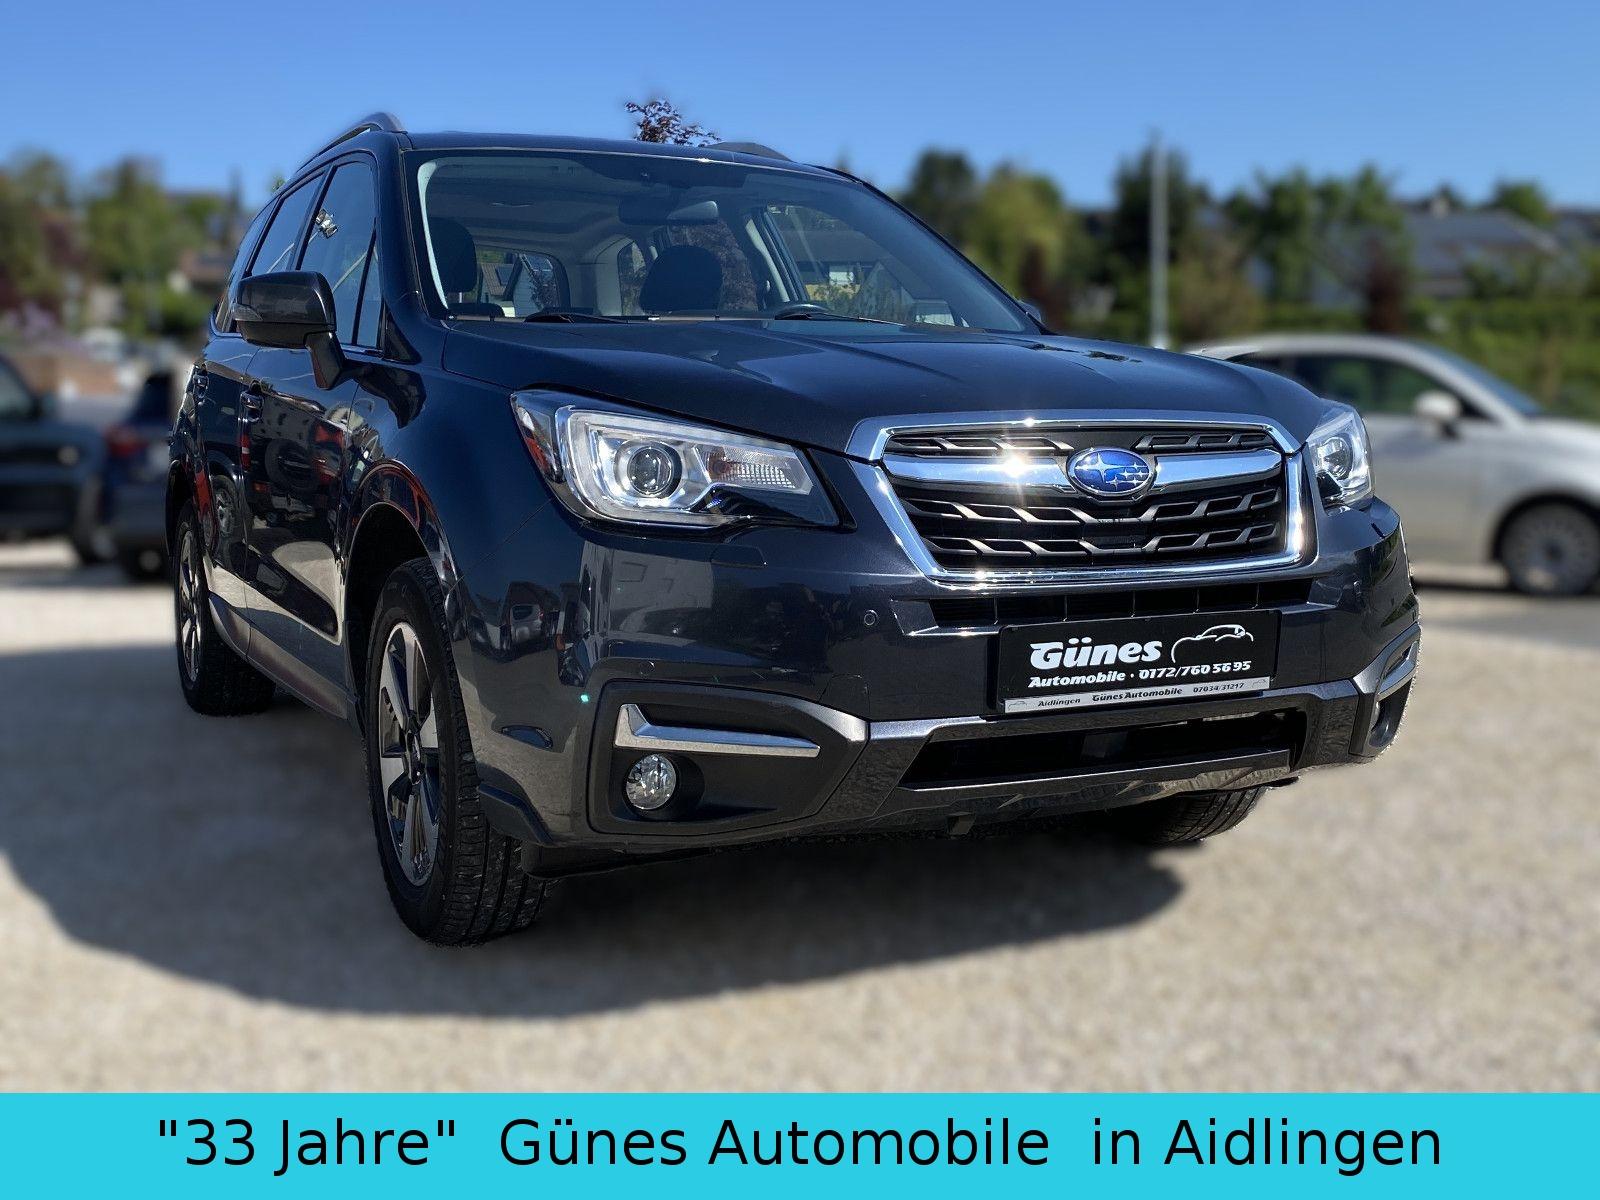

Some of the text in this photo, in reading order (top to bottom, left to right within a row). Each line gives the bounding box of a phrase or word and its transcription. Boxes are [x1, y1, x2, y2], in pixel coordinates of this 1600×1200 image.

[1028, 636, 1163, 670] Günes
[1027, 670, 1126, 688] Automobile
[1139, 664, 1211, 680] 0172/760
[1038, 698, 1081, 707] Aidlingen
[1092, 692, 1123, 702] Günes
[1125, 687, 1183, 700] Automobile
